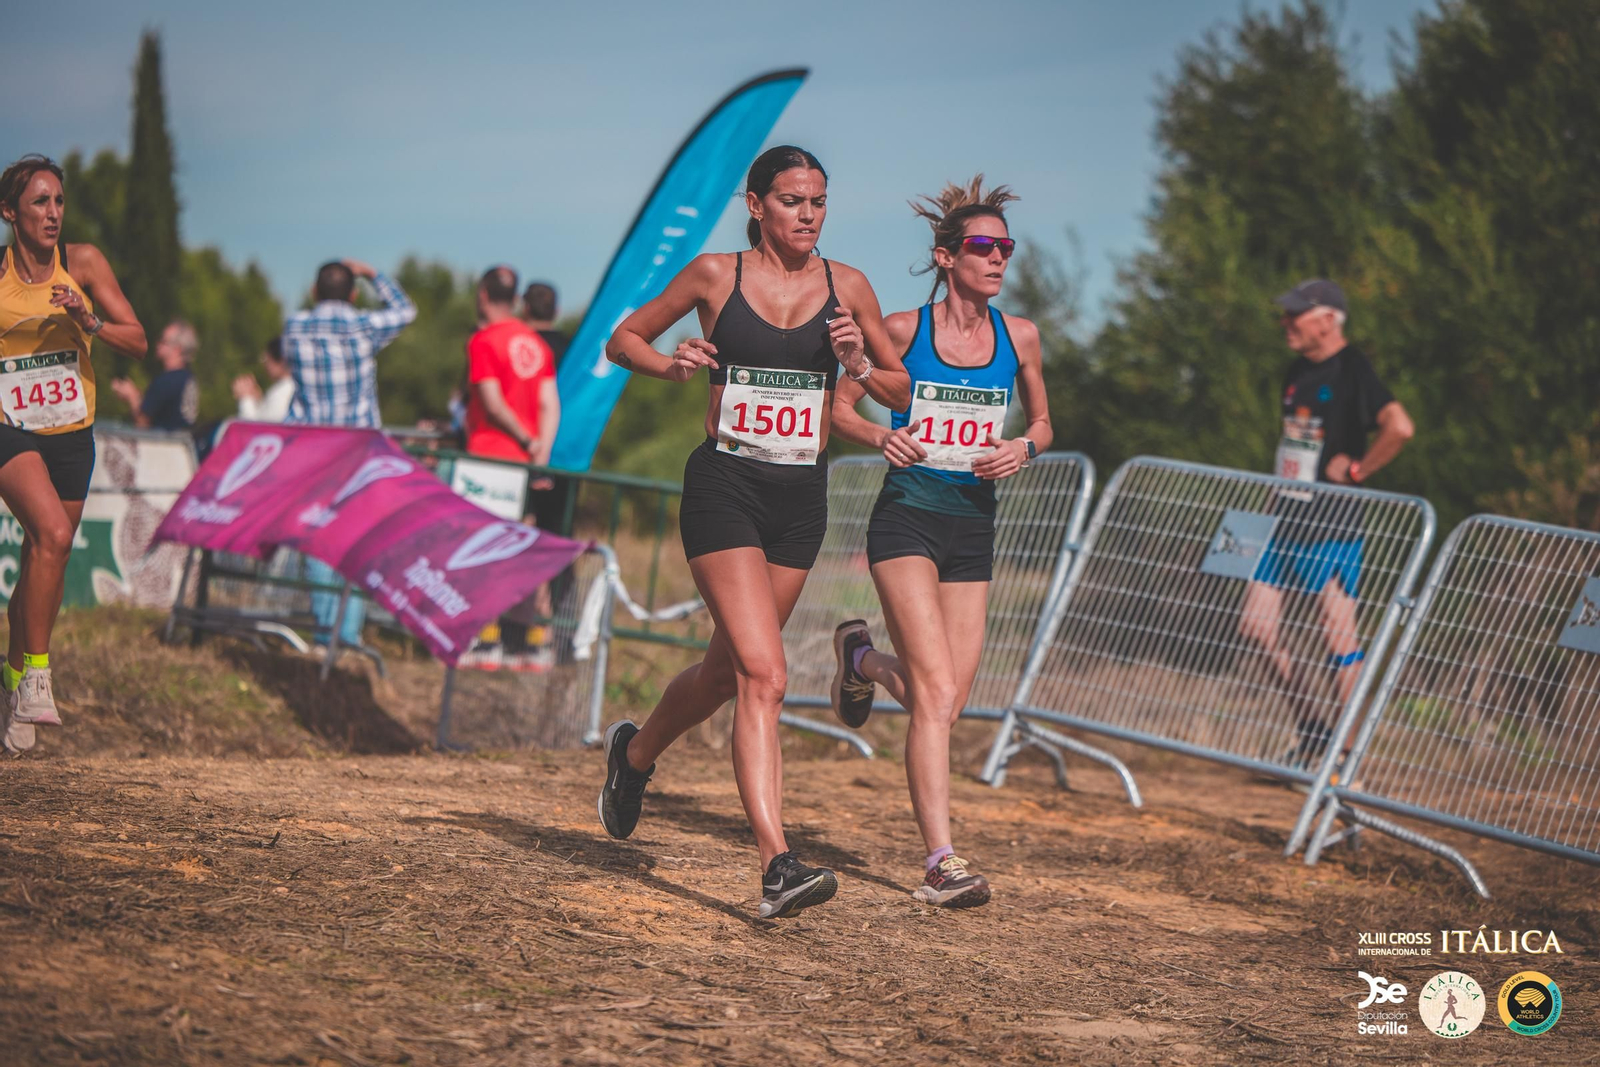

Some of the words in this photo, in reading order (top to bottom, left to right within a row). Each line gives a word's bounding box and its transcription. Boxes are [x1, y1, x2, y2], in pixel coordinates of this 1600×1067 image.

[11, 377, 78, 411] 1433
[756, 372, 801, 386] ITÁLICA
[942, 389, 986, 403] ITÁLICA
[731, 402, 813, 437] 1501
[918, 416, 994, 448] 1101
